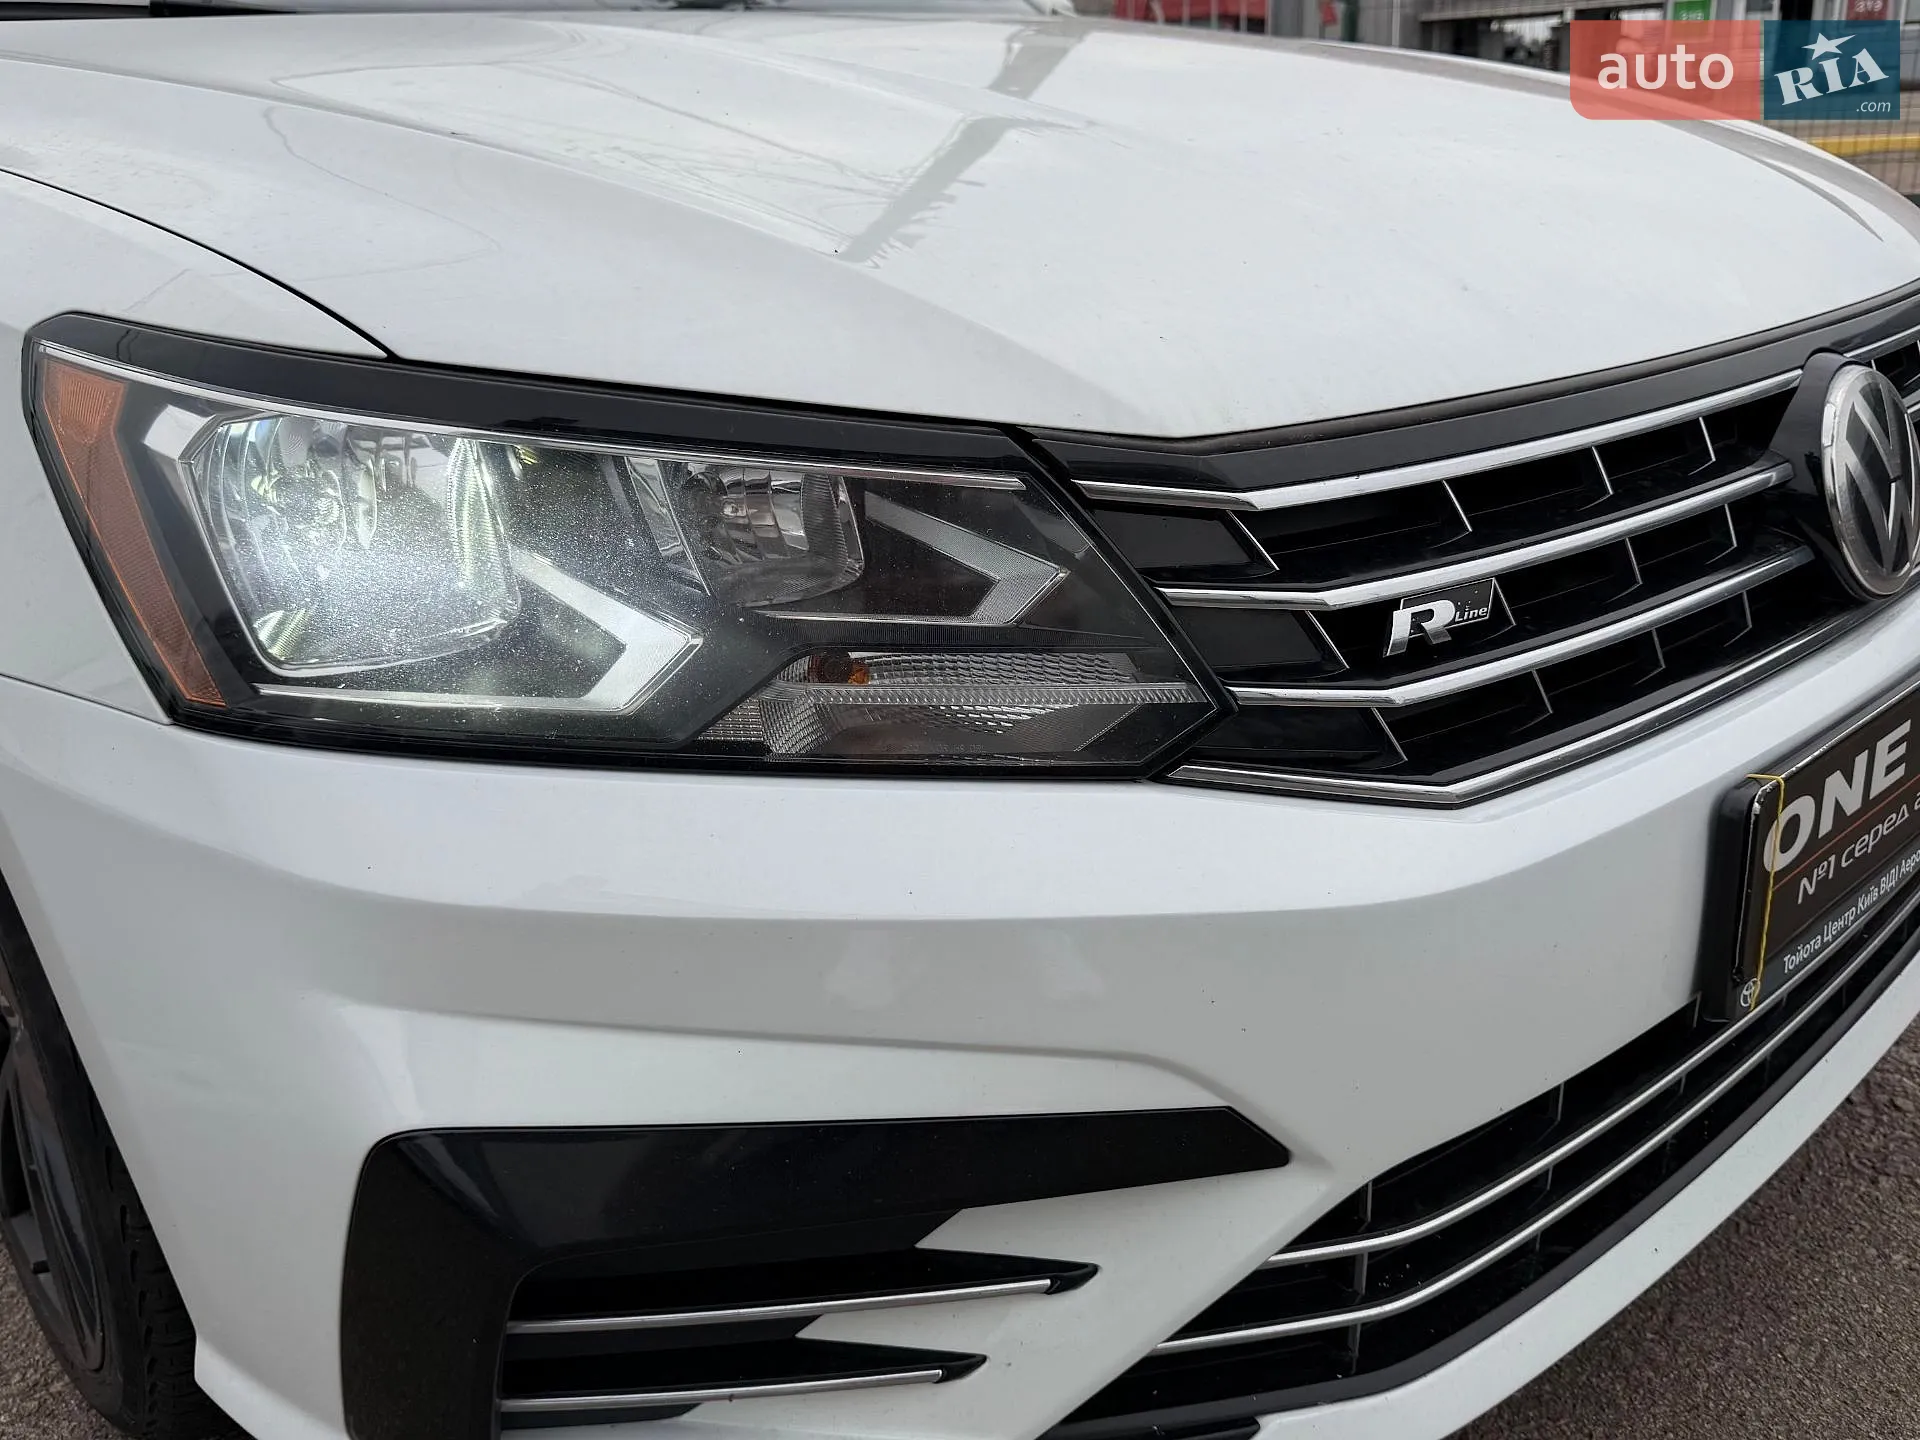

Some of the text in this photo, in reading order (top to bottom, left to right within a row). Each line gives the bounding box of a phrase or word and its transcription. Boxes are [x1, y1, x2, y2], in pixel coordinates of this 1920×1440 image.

[1384, 599, 1488, 657] R Line
[1763, 719, 1911, 872] ONE
[1841, 804, 1909, 868] серед
[1783, 934, 1821, 973] Тойота
[1823, 906, 1857, 942] Центр
[1857, 885, 1879, 914] Київ
[1879, 865, 1899, 895] ВІДІ
